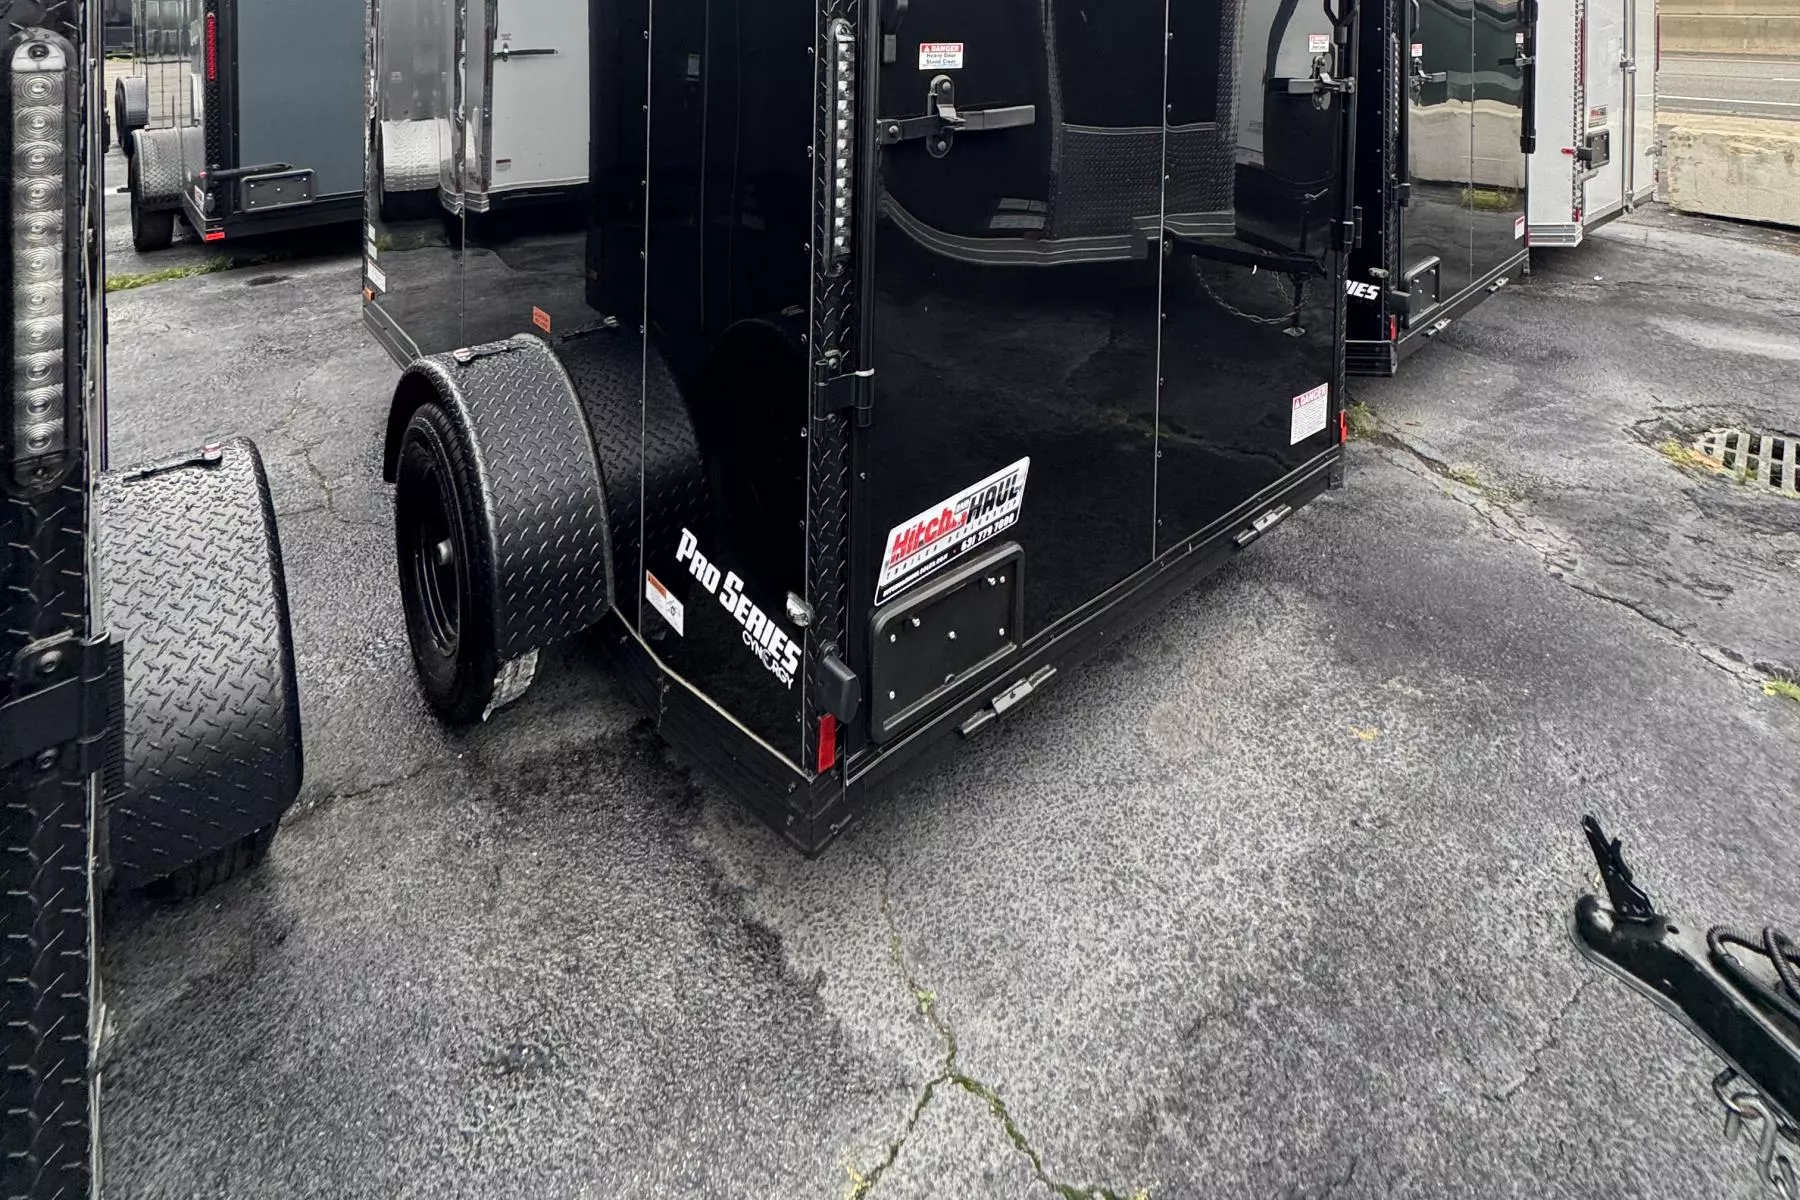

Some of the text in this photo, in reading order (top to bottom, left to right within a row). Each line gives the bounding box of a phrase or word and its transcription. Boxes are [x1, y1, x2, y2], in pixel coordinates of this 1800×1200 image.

[1300, 385, 1326, 407] DANGER
[966, 473, 1021, 525] HAUL
[890, 506, 955, 565] Hitch
[675, 527, 802, 676] PRO SERIES
[742, 630, 794, 691] CYNERGY
